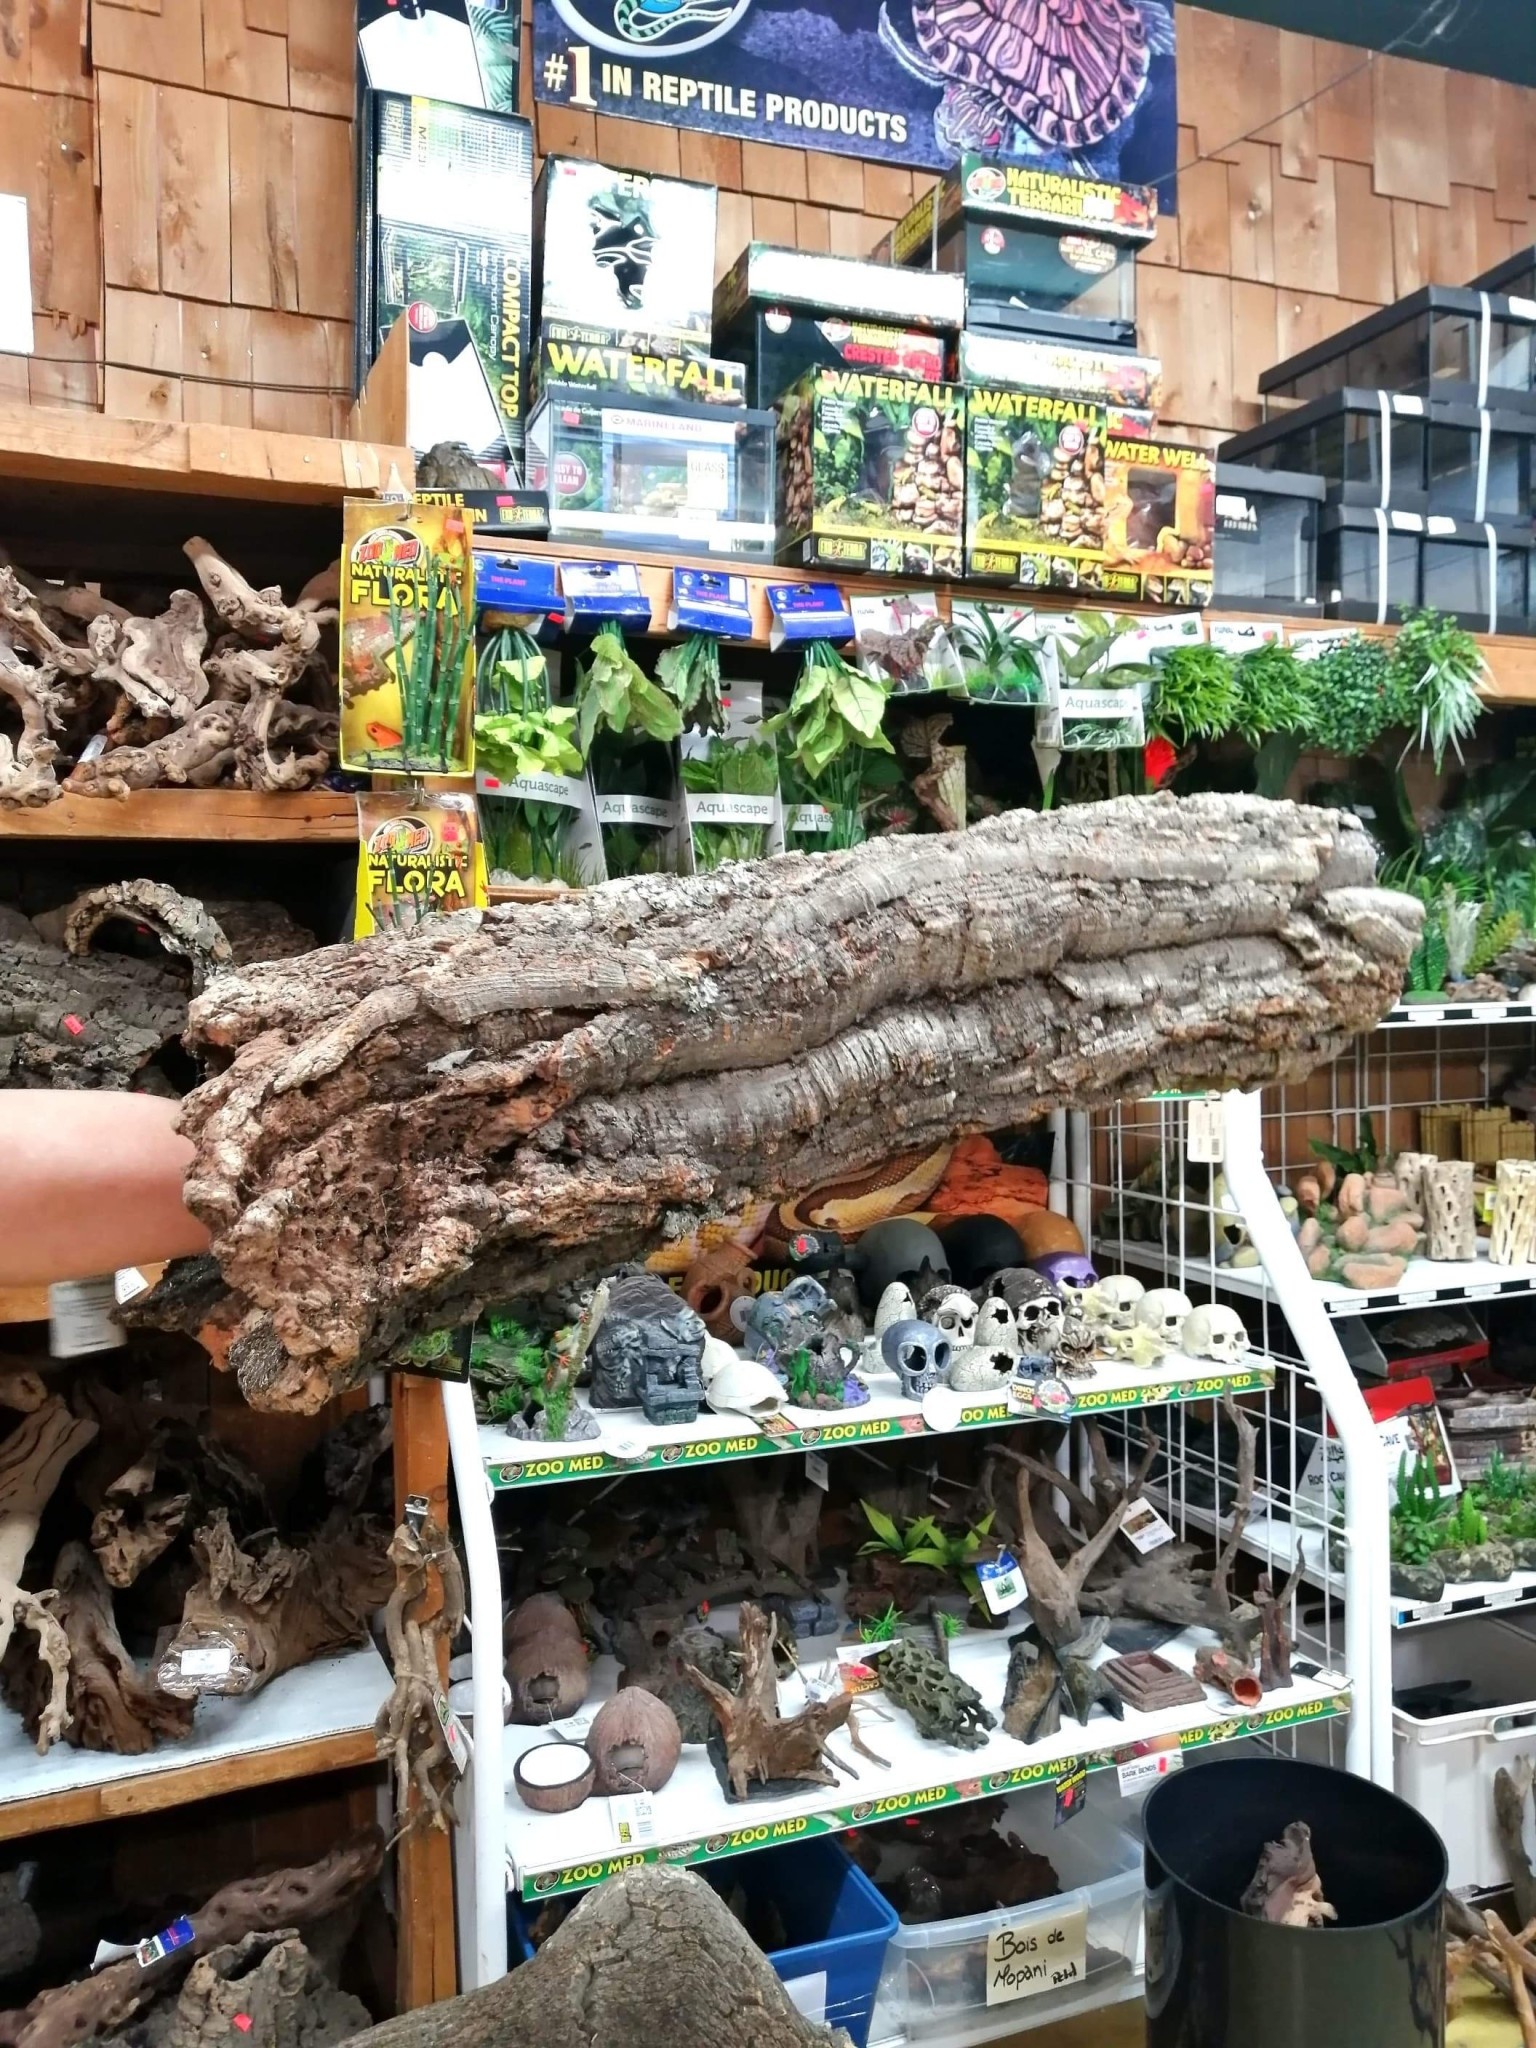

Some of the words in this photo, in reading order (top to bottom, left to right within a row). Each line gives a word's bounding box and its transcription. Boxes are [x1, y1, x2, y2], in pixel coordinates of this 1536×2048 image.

[544, 46, 598, 107] #1
[602, 63, 632, 97] IN
[643, 70, 756, 119] REPTILE
[766, 93, 908, 143] PRODUCTS
[1007, 167, 1122, 206] NATURALISTIC
[1009, 187, 1083, 217] TERRARI
[547, 343, 740, 393] WATERFALL
[500, 370, 520, 419] TOP
[820, 369, 957, 408] WATERFALL
[972, 390, 1098, 427] WATERFALL
[1104, 439, 1160, 465] WATER
[1162, 447, 1211, 472] WELL
[412, 493, 465, 507] EPTILE
[351, 561, 462, 585] NATURALITC
[351, 579, 459, 618] FLORA
[1065, 696, 1127, 711] Aquascap
[509, 777, 569, 797] Aquascape
[696, 801, 769, 815] Aquscape
[368, 870, 466, 898] FLORA
[1078, 1391, 1108, 1409] ZOO
[1111, 1389, 1138, 1405] MED
[1195, 1379, 1225, 1393] ZOO
[961, 1408, 987, 1424] OO
[988, 1404, 1008, 1420] ME
[822, 1424, 857, 1442] ZOO
[859, 1421, 891, 1438] MED
[685, 1441, 722, 1459] ZOO
[725, 1436, 759, 1454] MED
[525, 1459, 565, 1479] ZOO
[568, 1455, 604, 1473] MED
[1265, 1709, 1296, 1725] ZOO
[1297, 1700, 1324, 1717] MED
[1179, 1728, 1204, 1745] MED
[1011, 1764, 1044, 1783] ZOO
[1047, 1756, 1077, 1775] MED
[875, 1794, 911, 1814] ZOO
[914, 1786, 947, 1805] MED
[730, 1826, 769, 1847] ZOO
[772, 1818, 808, 1838] MED
[562, 1862, 602, 1886] ZOO
[607, 1853, 645, 1874] MED
[993, 1930, 1039, 1963] Bois
[1047, 1928, 1066, 1945] de
[993, 1959, 1048, 1991] Mopani
